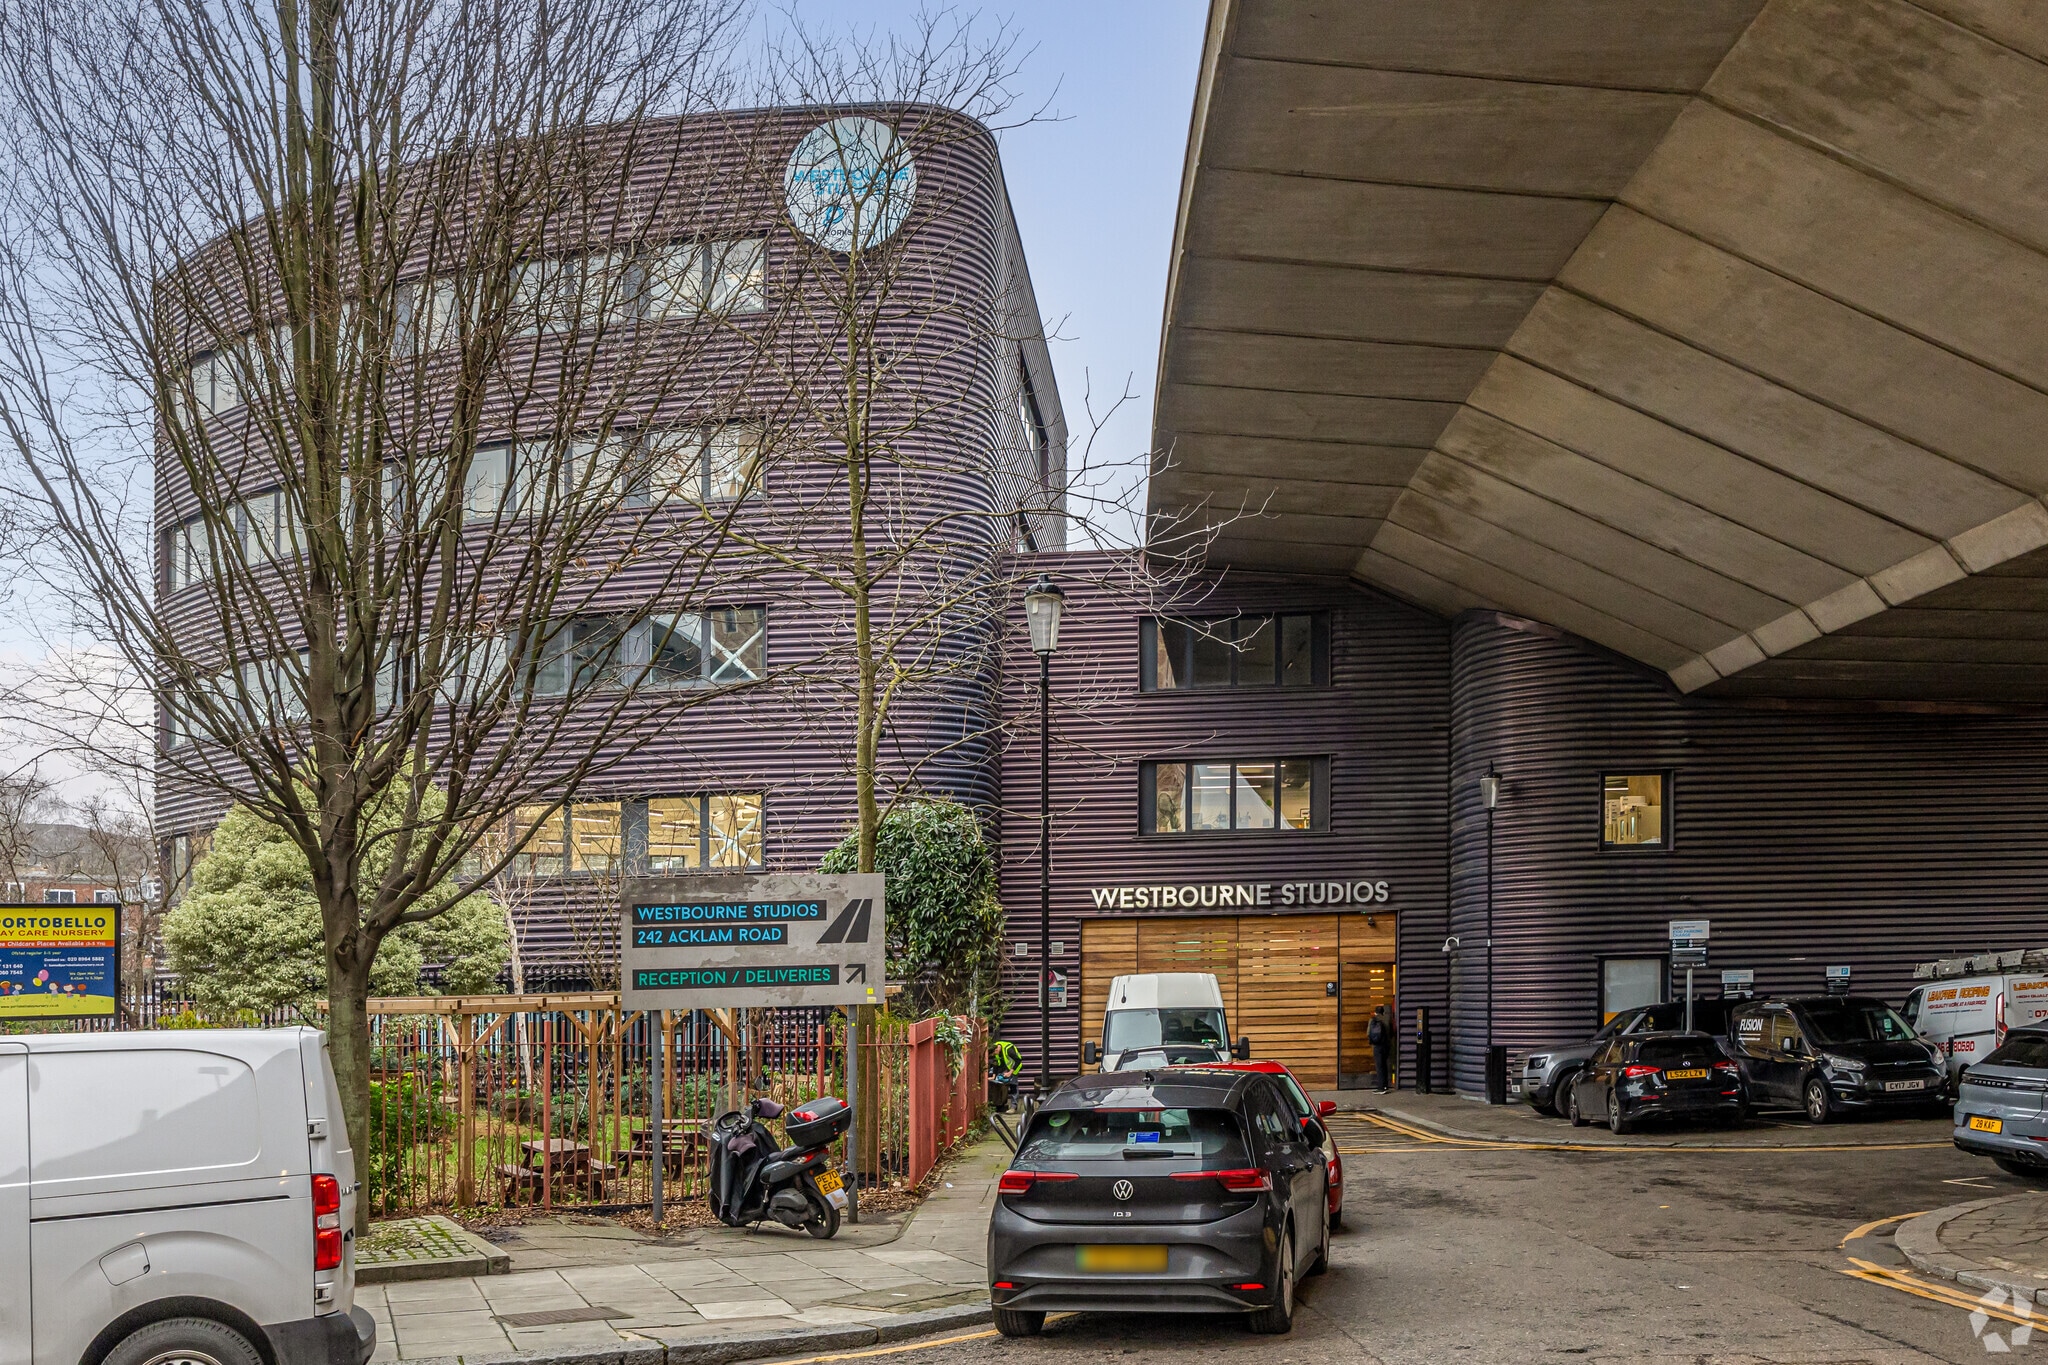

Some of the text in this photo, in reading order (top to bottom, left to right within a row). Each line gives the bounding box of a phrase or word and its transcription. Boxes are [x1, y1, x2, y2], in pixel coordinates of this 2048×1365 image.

[1090, 881, 1389, 909] WESTBOURNE STUDIOS
[637, 903, 819, 921] WESTBOURNE STUDIOS
[0, 917, 106, 928] ORTOBELLO
[637, 927, 782, 944] 242 ACKLAM ROAD
[638, 971, 726, 986] RECEPTION
[746, 968, 831, 983] DELIVERIES
[2035, 1010, 2048, 1018] 07
[1740, 1018, 1764, 1030] FUSION
[1974, 1079, 2007, 1087] PORSCHE
